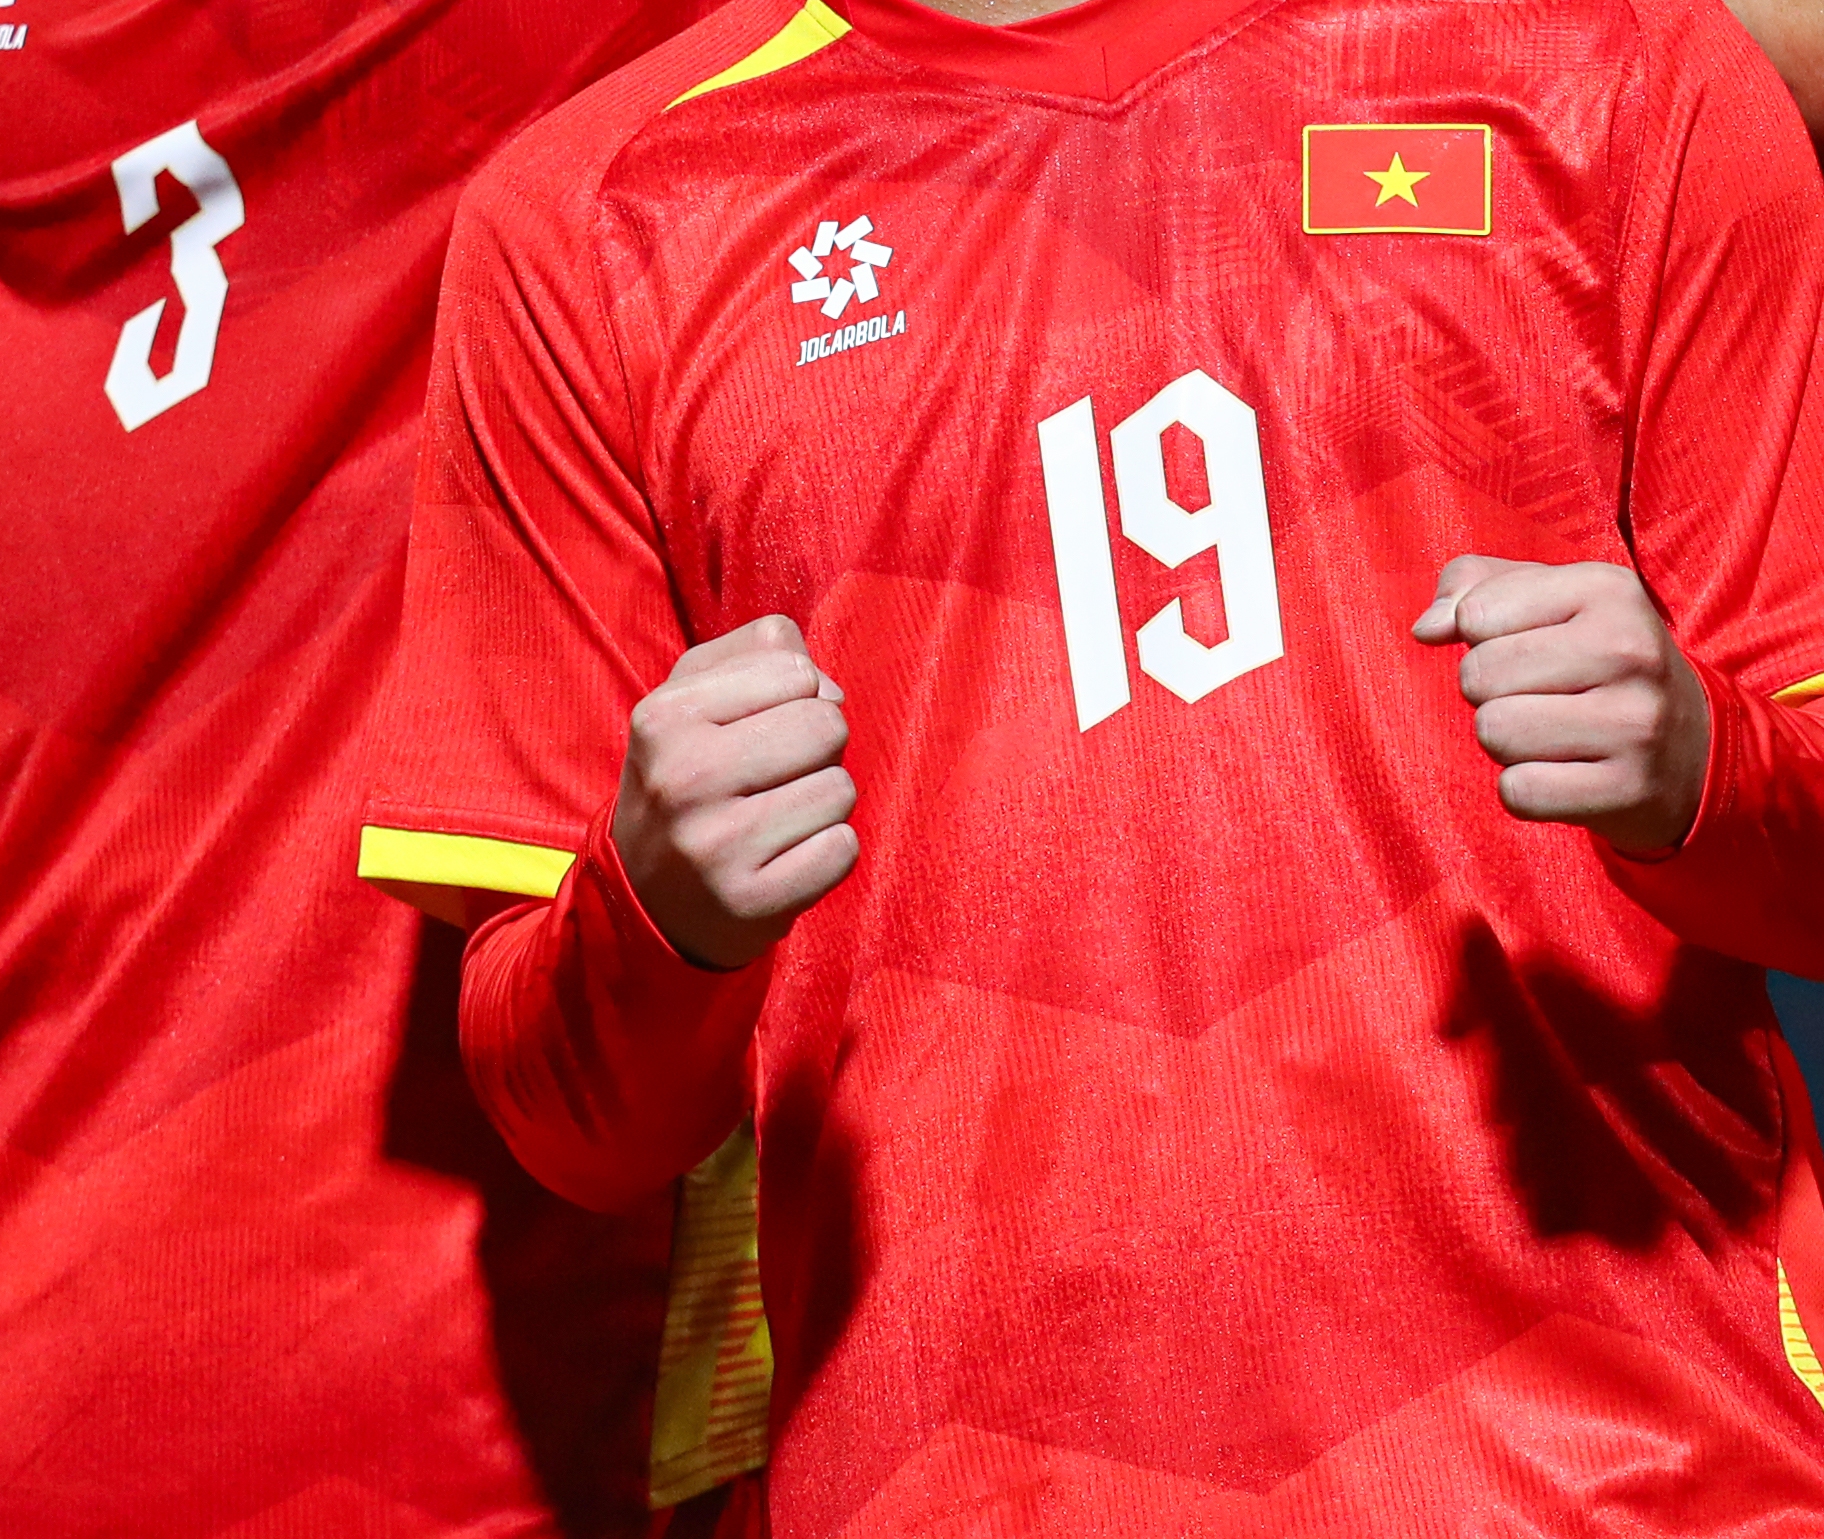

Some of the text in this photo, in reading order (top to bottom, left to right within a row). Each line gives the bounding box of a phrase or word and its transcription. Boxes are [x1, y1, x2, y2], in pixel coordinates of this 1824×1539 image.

[104, 120, 244, 432] 3
[795, 309, 906, 367] JOGARBOLA
[1038, 369, 1284, 733] 19
